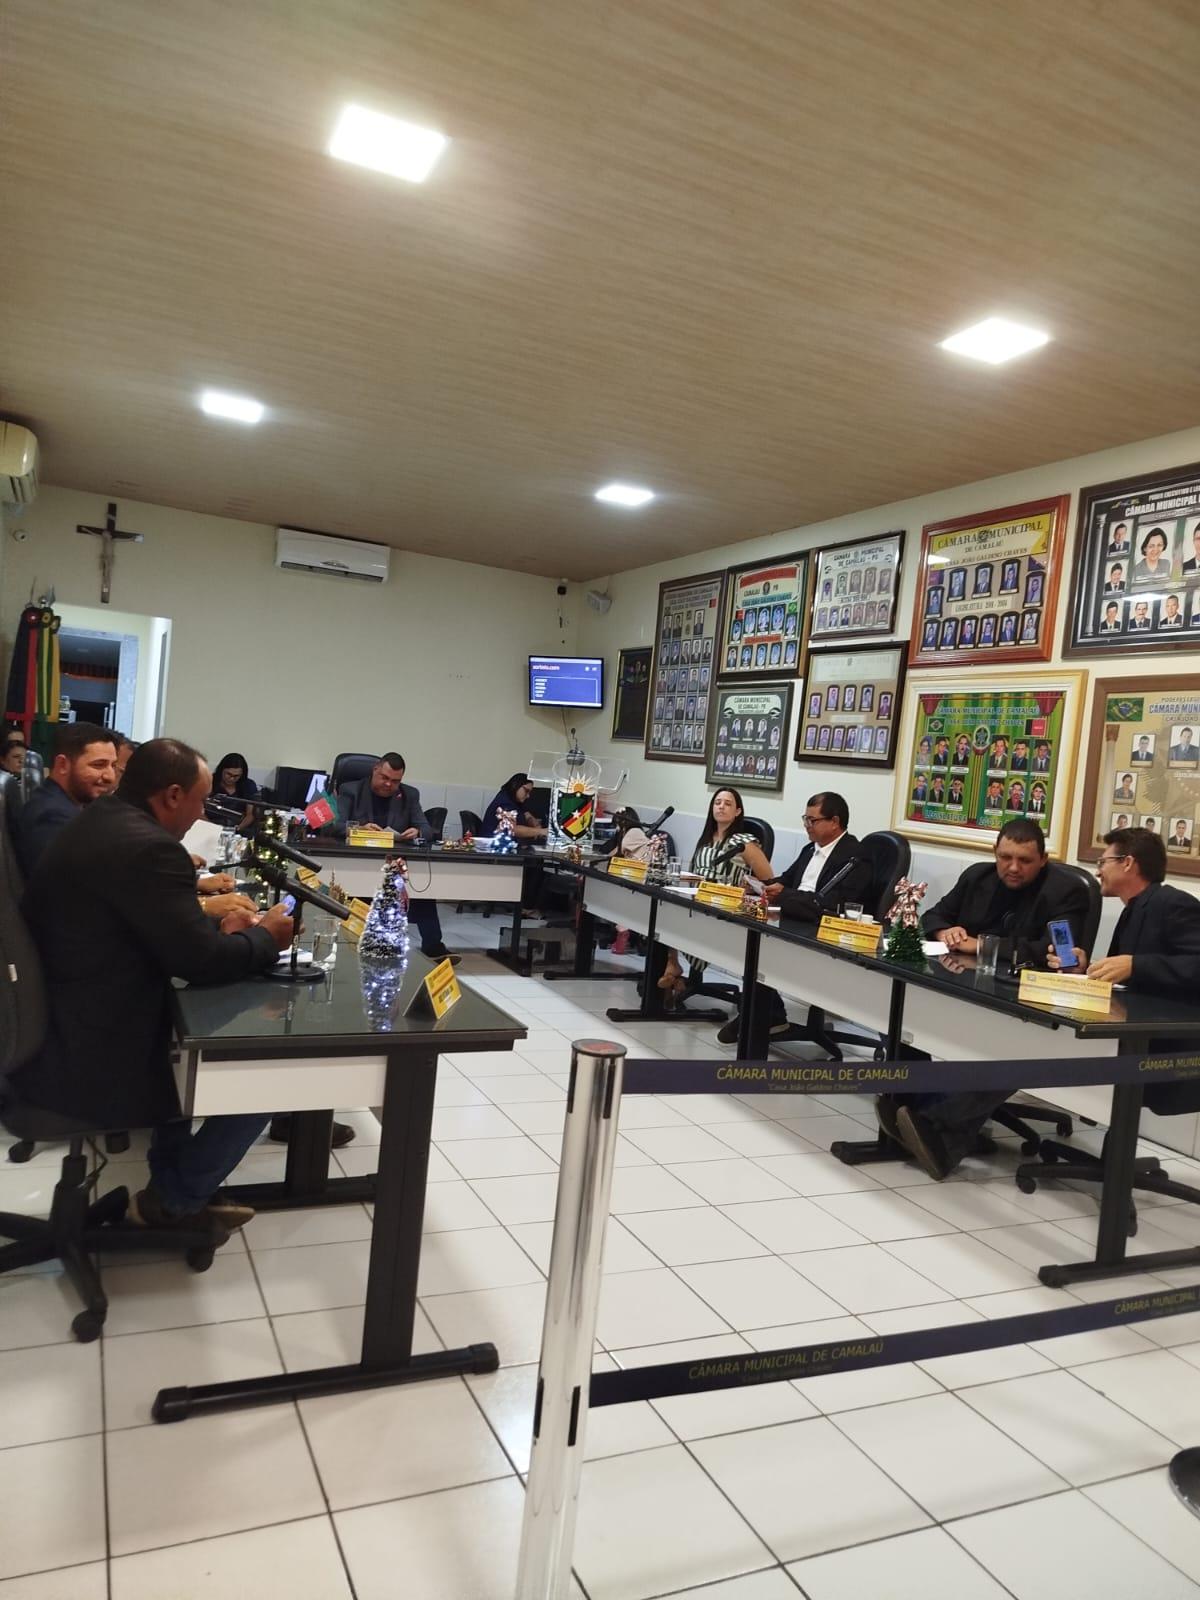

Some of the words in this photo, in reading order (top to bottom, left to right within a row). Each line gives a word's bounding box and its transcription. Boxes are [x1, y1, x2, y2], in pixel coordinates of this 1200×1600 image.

[1156, 494, 1197, 511] MUNICIPAL
[989, 521, 1043, 539] MUNICIPAL
[717, 1064, 767, 1080] CÂMARA
[771, 1069, 834, 1081] MUNICIPAL
[838, 1069, 853, 1081] DE
[857, 1065, 909, 1080] CAMALAÚ
[1139, 1057, 1175, 1071] CÂMARA
[1114, 1299, 1150, 1315] CÂMARA
[689, 1361, 740, 1379] CÂMARA
[744, 1353, 809, 1371] MUNICIPAL
[813, 1350, 828, 1361] DE
[831, 1341, 884, 1360] CAMALAÚ
